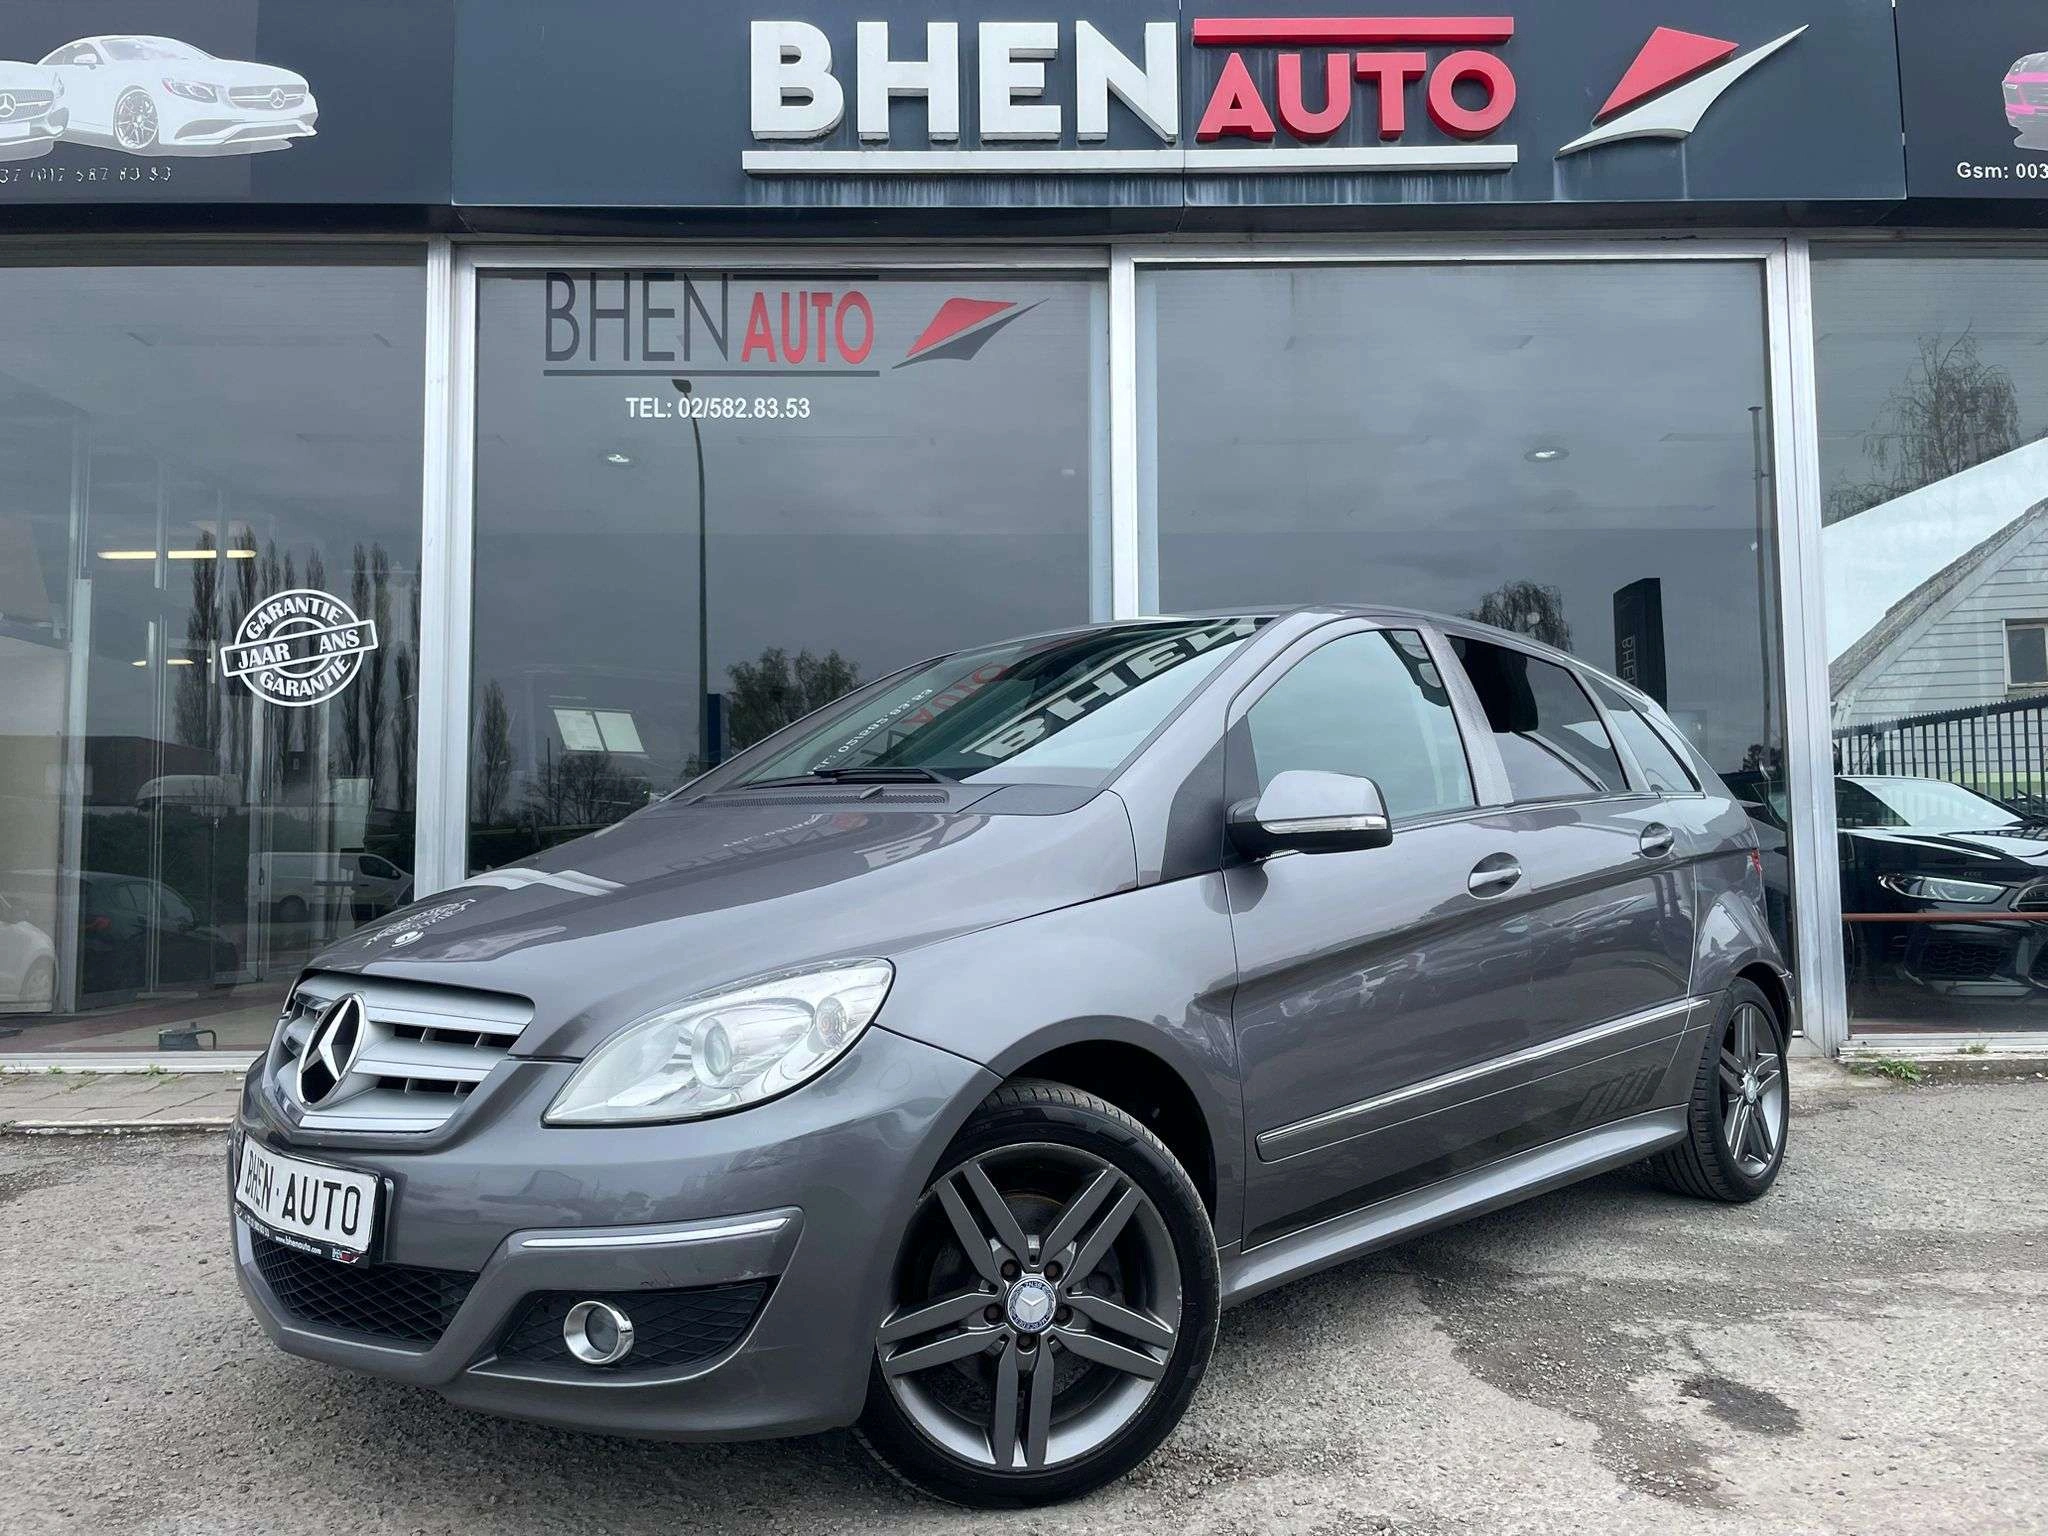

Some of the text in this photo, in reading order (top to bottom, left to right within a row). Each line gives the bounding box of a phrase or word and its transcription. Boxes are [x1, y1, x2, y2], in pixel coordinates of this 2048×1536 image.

[751, 21, 1516, 142] BHEN AUTO
[1957, 162, 2008, 179] Gsm:
[545, 272, 874, 364] BHEN AUTO
[625, 397, 811, 418] TEL: 02/582.83.53
[246, 597, 343, 639] GARANTIE
[238, 629, 360, 669] JAAR ANS
[259, 655, 351, 697] GARANTIE
